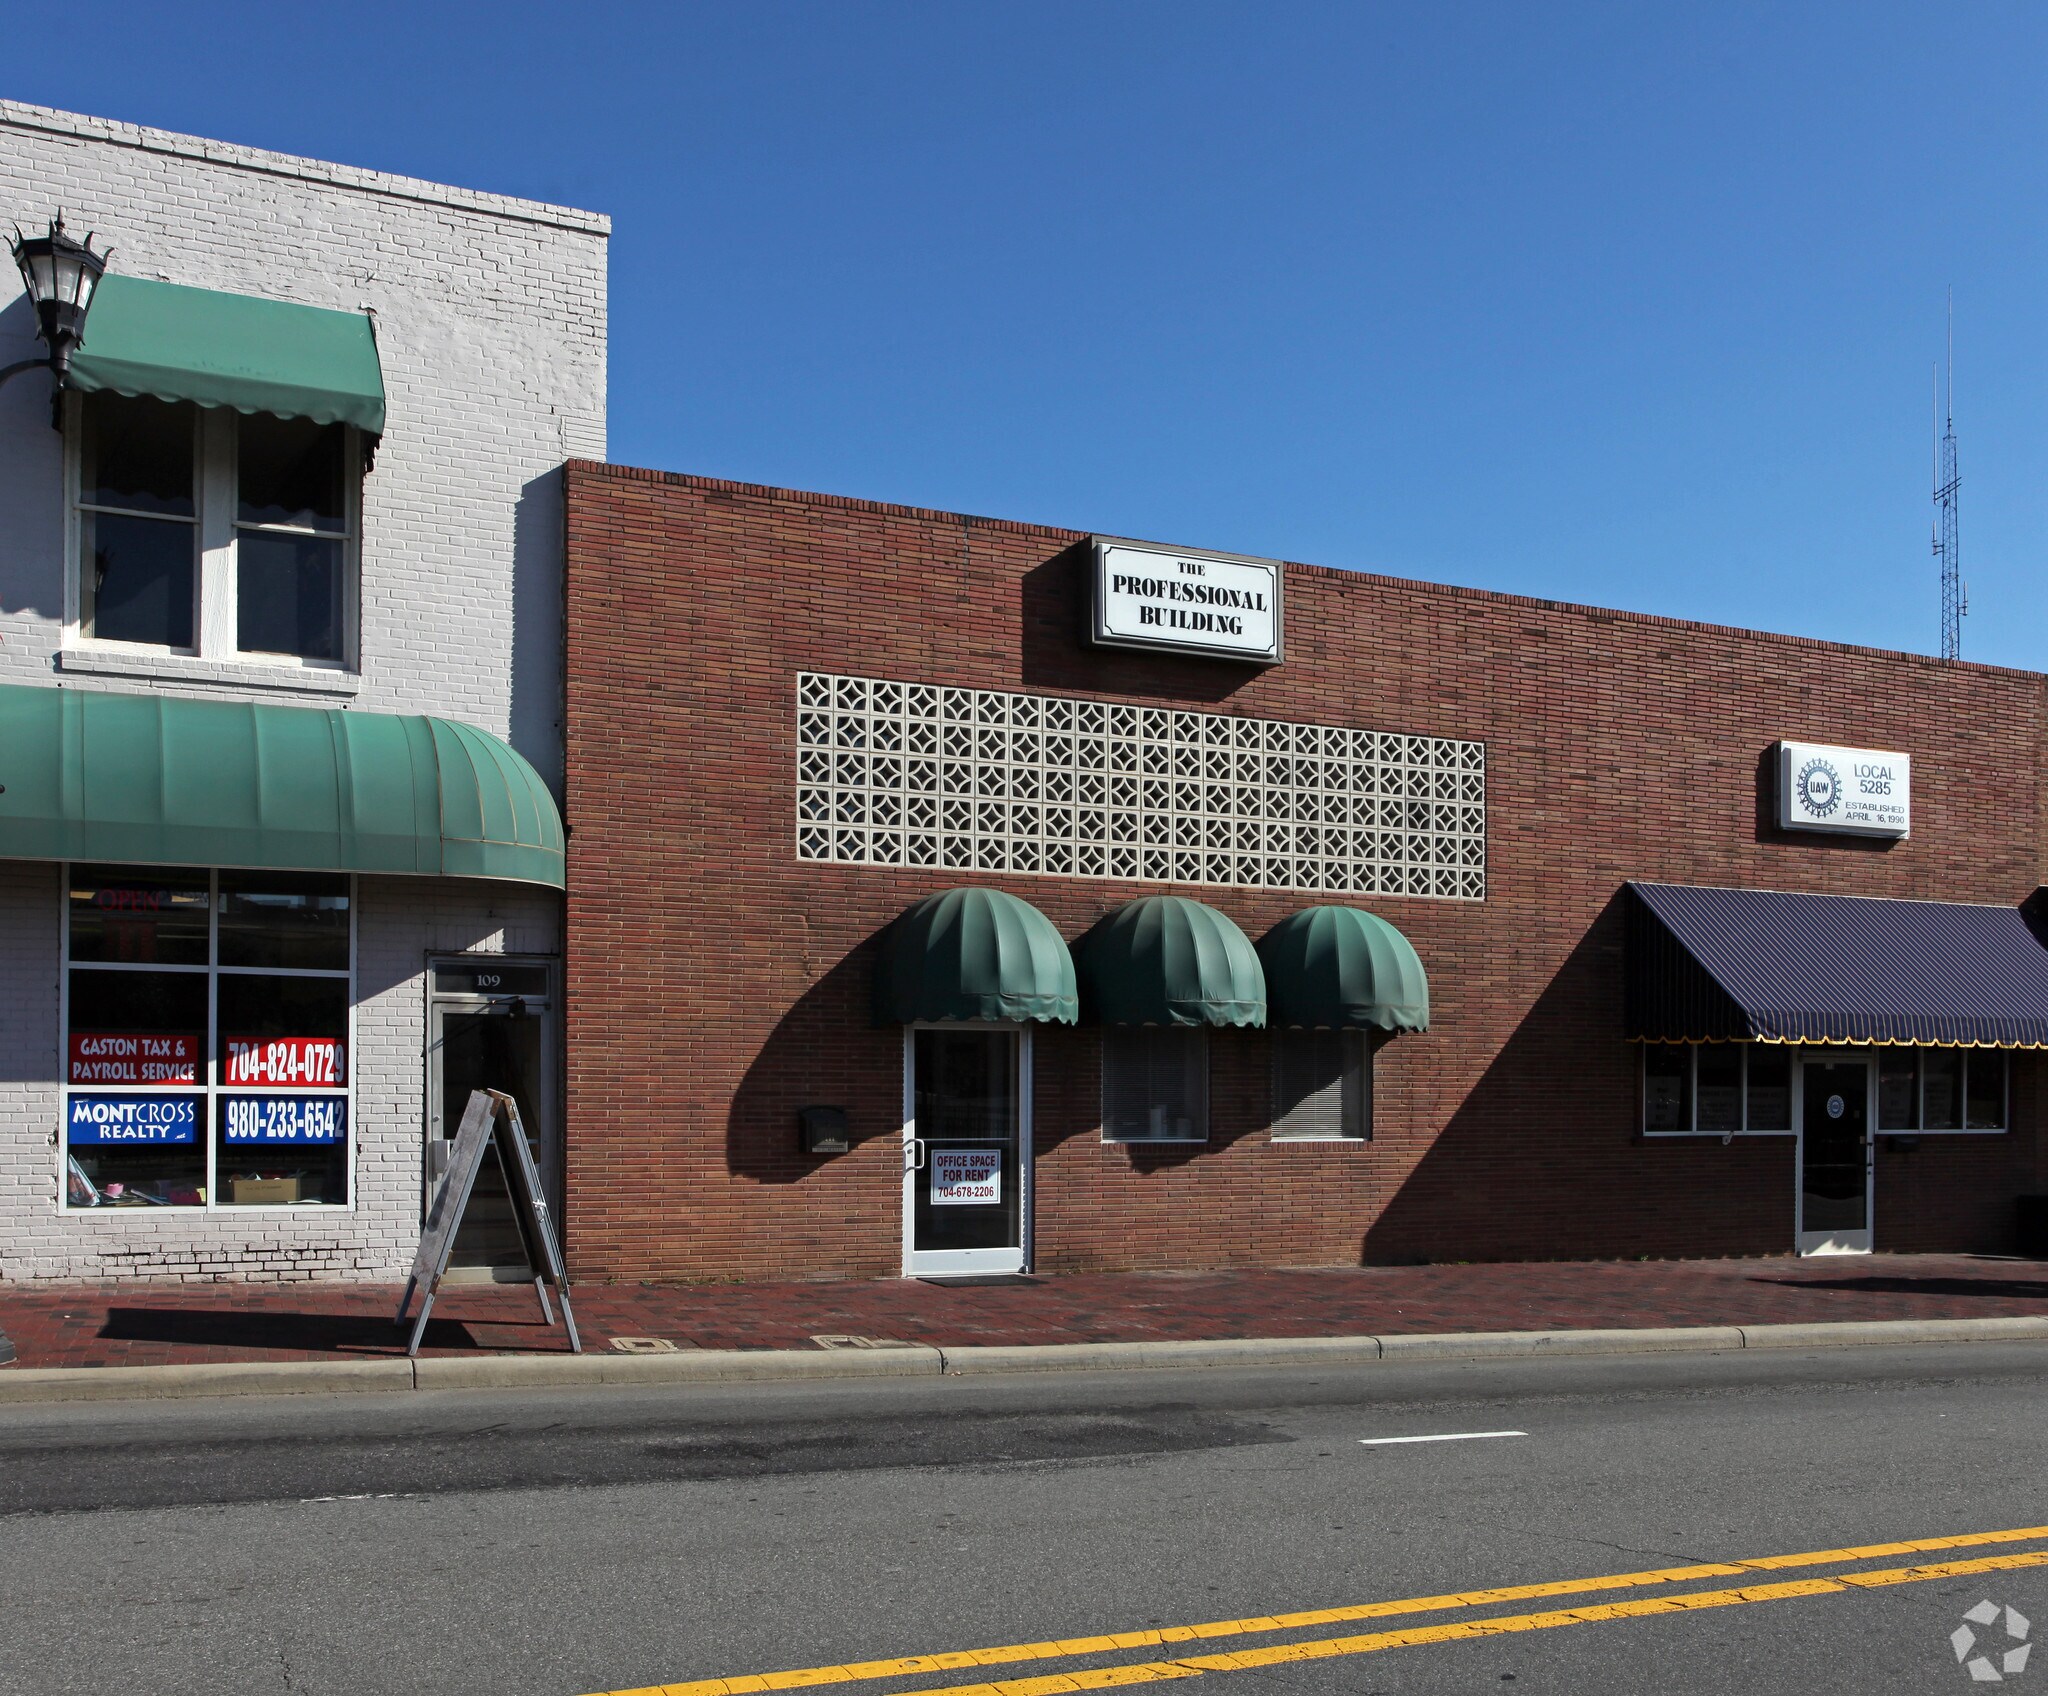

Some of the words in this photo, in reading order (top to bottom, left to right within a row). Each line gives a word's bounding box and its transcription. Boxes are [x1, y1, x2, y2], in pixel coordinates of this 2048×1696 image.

[1177, 561, 1206, 576] THE
[1112, 573, 1268, 613] PROFESSIONAL
[1139, 605, 1243, 635] BUILDING
[1854, 763, 1896, 781] LOCAL
[1810, 781, 1829, 794] UAW
[1859, 779, 1891, 796] 5285
[1845, 801, 1905, 814] ESTABLISHED
[1845, 811, 1872, 822] APRIL
[1876, 813, 1887, 824] 16,
[1888, 815, 1905, 824] 1990
[98, 888, 160, 912] OPEN
[477, 974, 501, 987] 109
[80, 1037, 137, 1056] GASTON
[141, 1039, 171, 1056] TAX
[175, 1039, 186, 1057] &
[72, 1061, 137, 1080] PAYROLL
[141, 1062, 195, 1081] SERVICE
[228, 1042, 345, 1083] 704-824-0729
[72, 1102, 194, 1124] MONTCROSS
[228, 1099, 344, 1138] 980-233-6542
[99, 1124, 171, 1139] REALTY
[937, 1155, 968, 1167] OFFICE
[970, 1155, 996, 1167] SPACE
[943, 1169, 962, 1181] FOR
[965, 1169, 990, 1181] RENT
[938, 1186, 994, 1198] 704-678-2206
